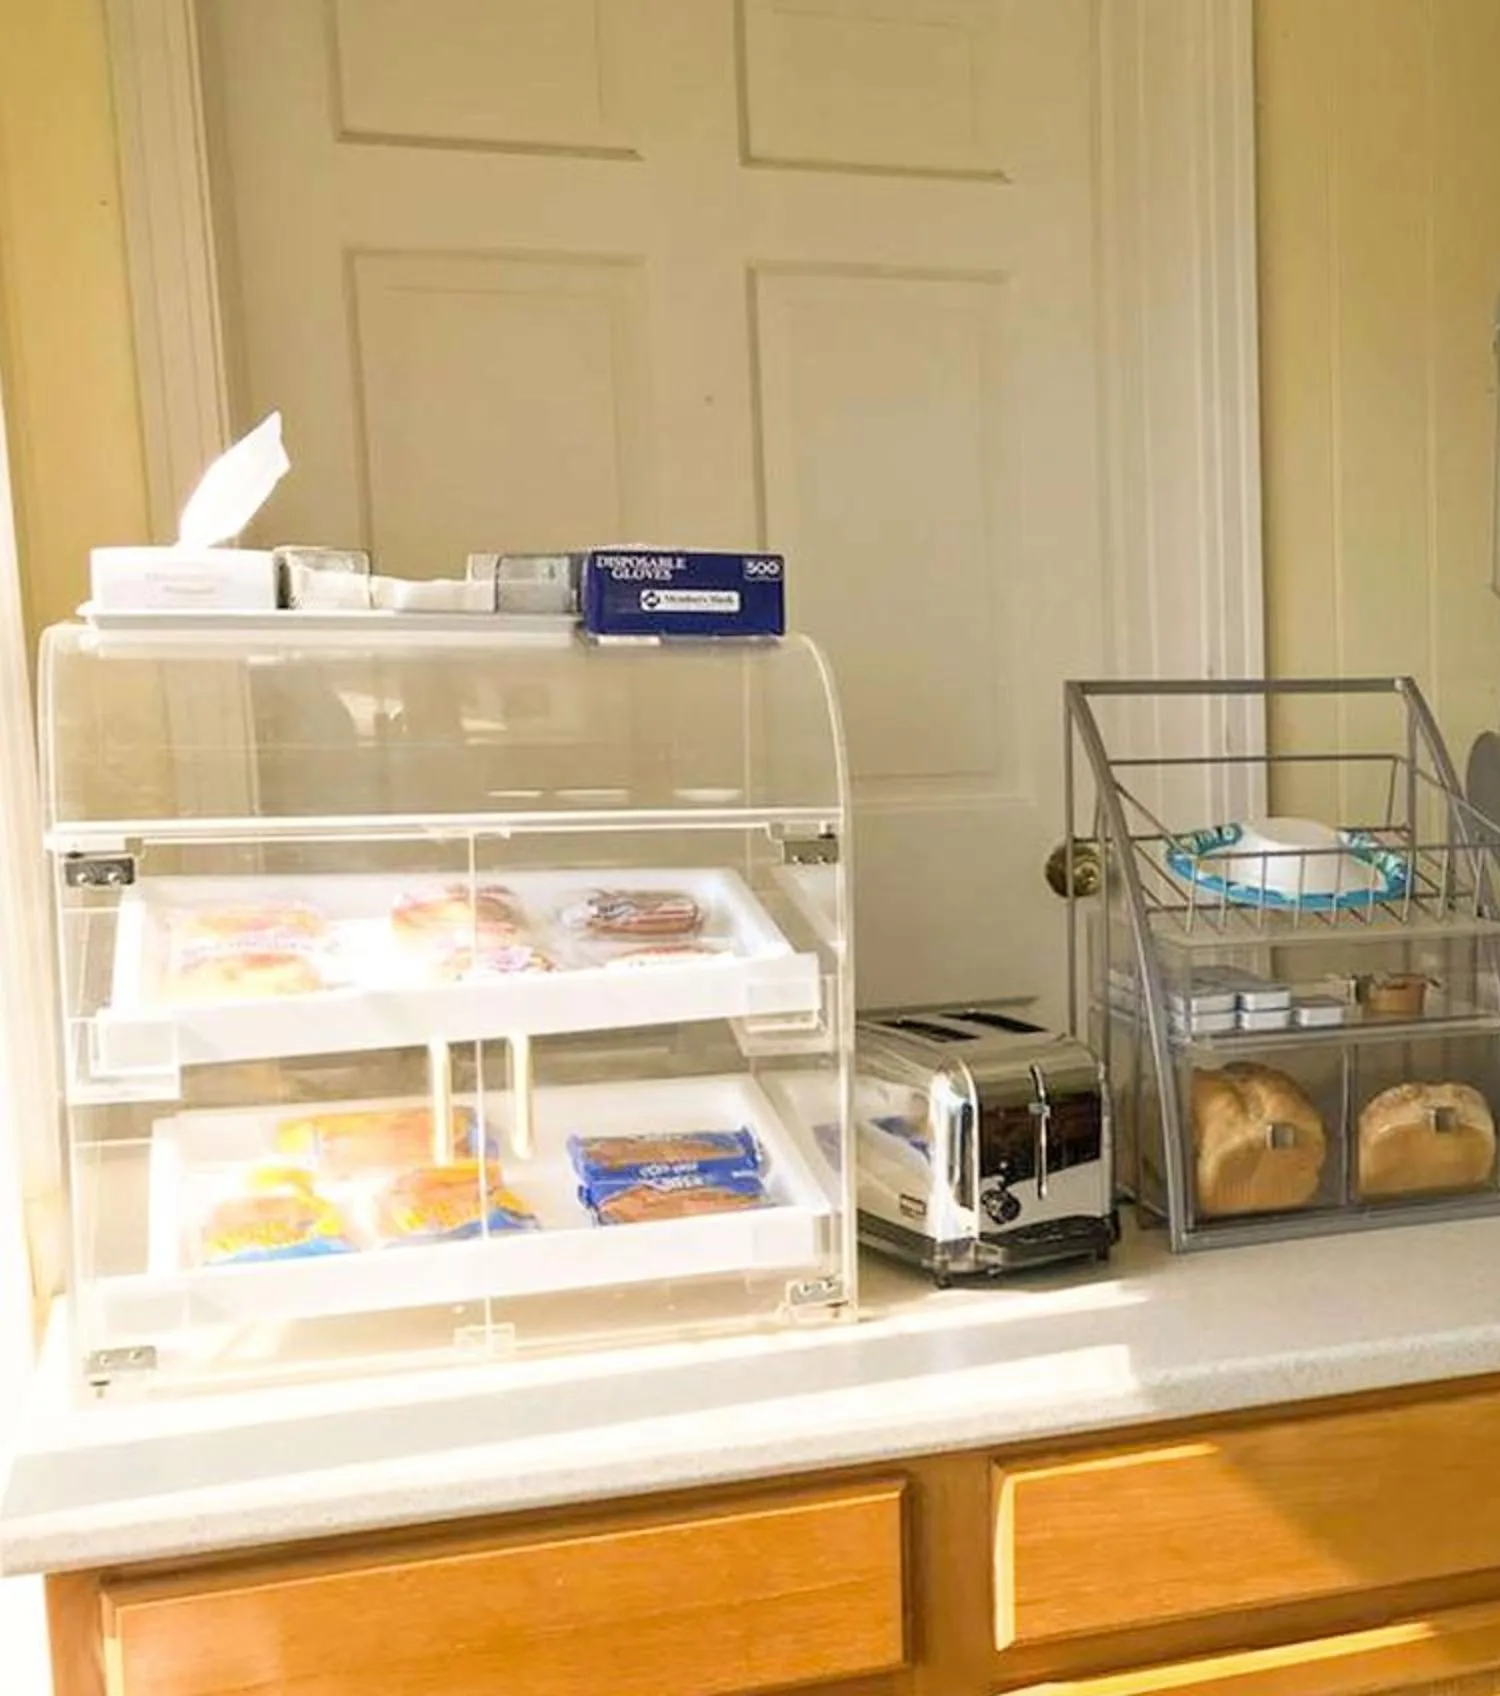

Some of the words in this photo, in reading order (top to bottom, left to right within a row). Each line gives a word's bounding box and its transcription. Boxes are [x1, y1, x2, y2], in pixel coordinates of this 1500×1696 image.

[596, 556, 687, 570] DISPOSABLE
[745, 560, 781, 575] 500
[611, 568, 673, 581] GLOVES
